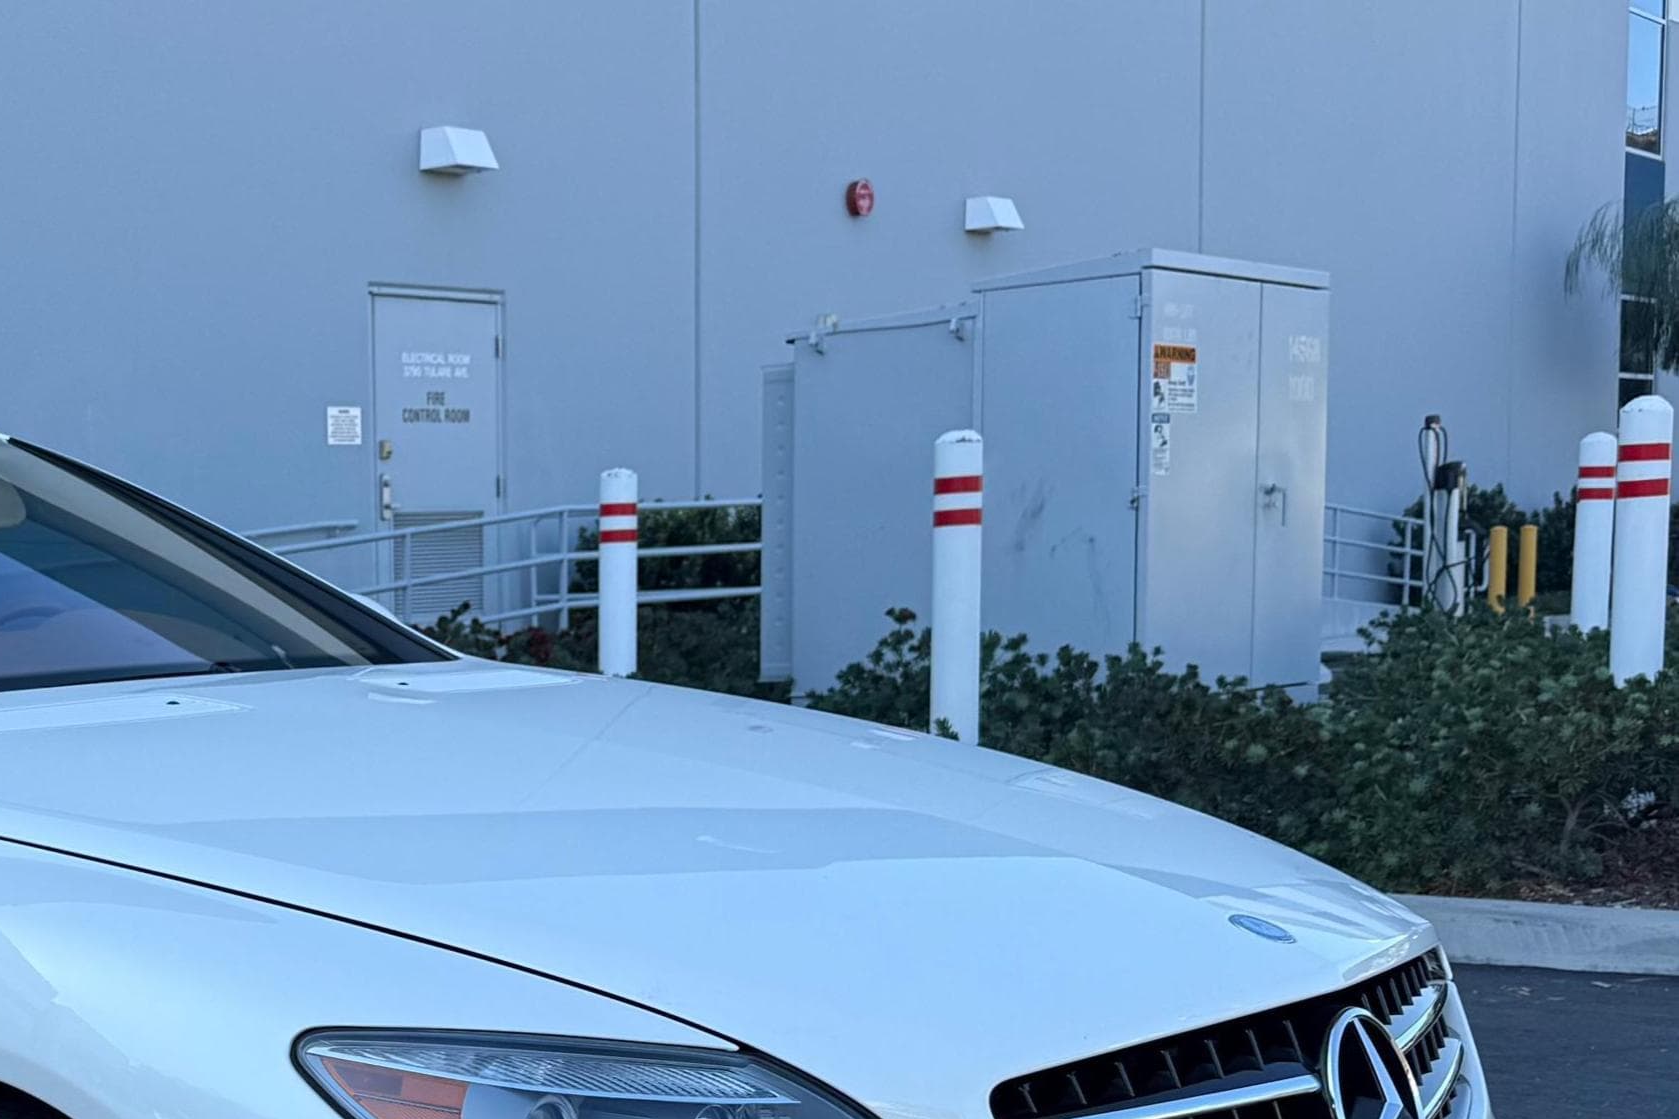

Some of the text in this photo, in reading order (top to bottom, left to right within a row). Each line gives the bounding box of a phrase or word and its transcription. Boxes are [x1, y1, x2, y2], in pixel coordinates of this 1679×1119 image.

[447, 354, 471, 365] ROOM
[426, 391, 445, 406] FIRE
[402, 408, 470, 423] CONTROL ROOM
